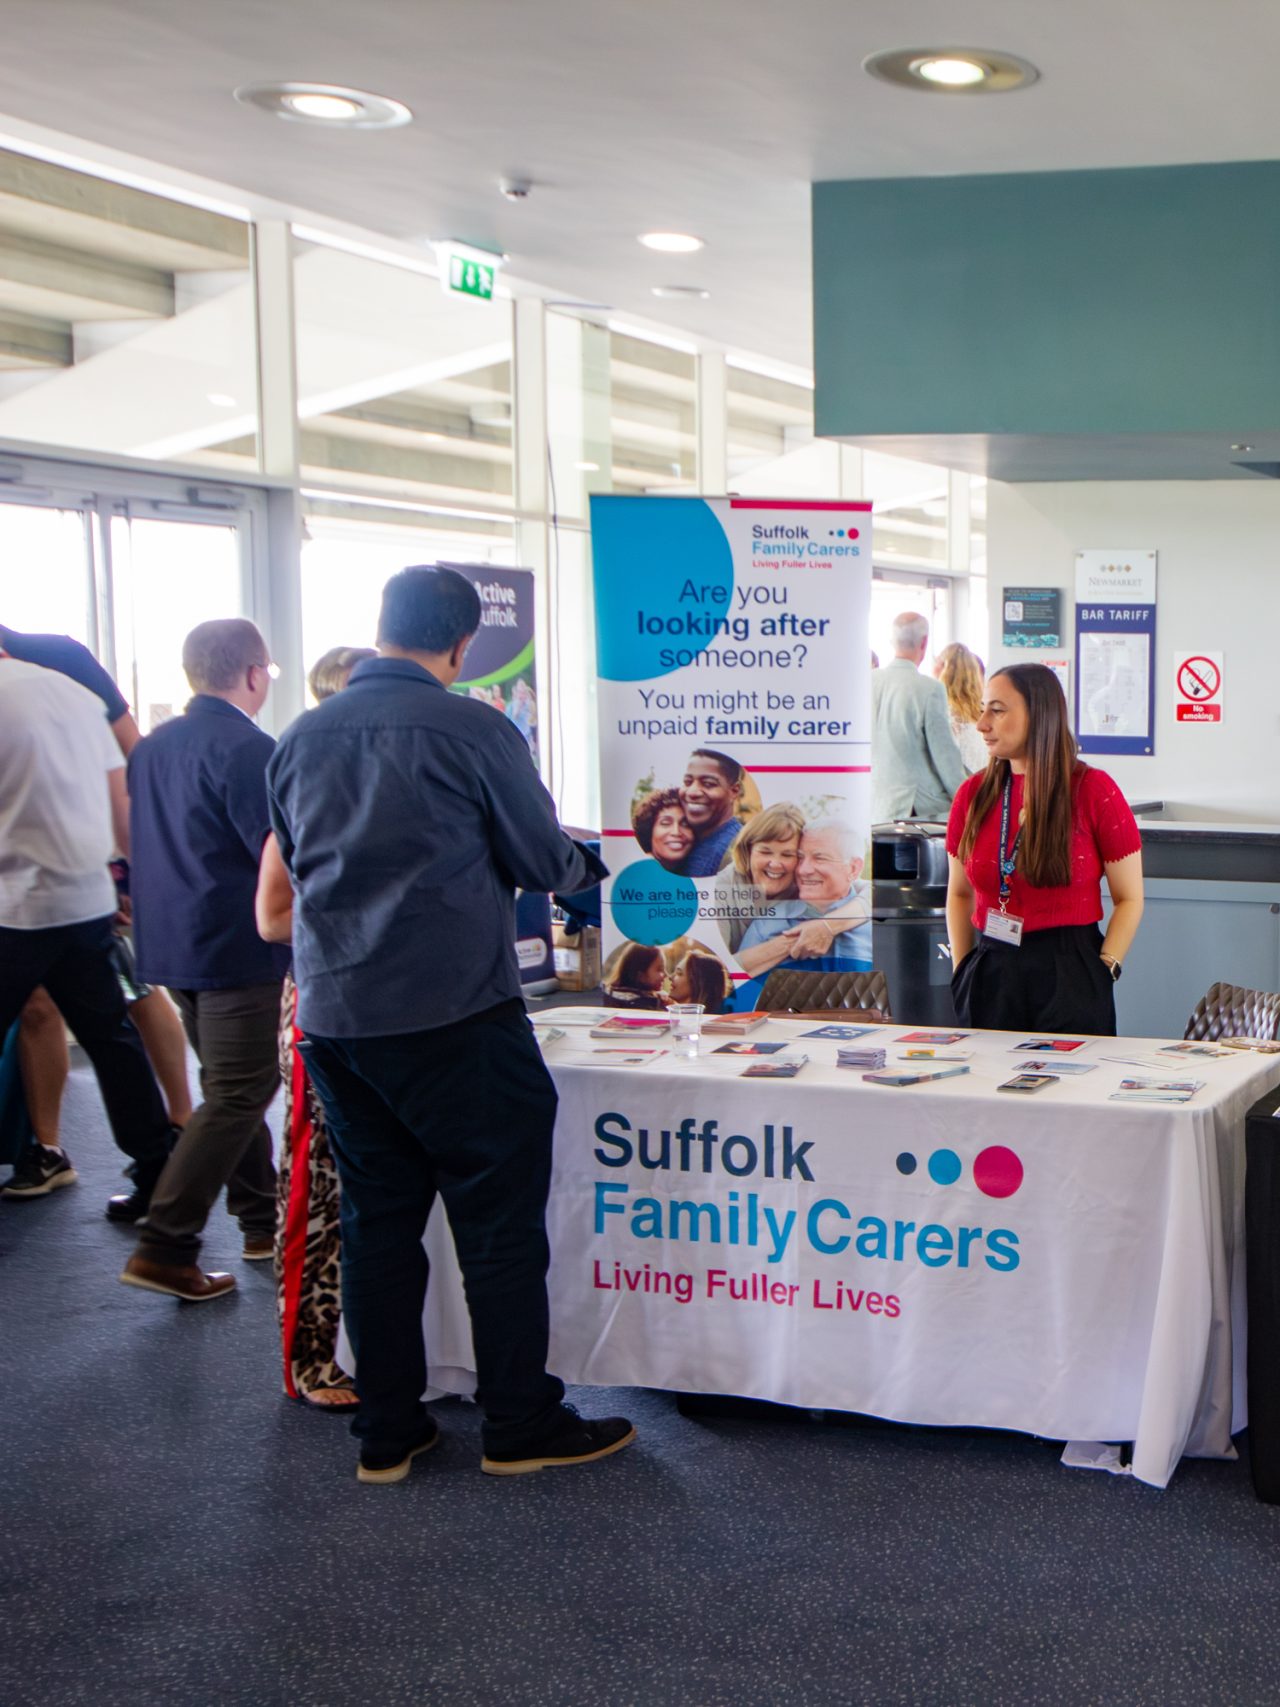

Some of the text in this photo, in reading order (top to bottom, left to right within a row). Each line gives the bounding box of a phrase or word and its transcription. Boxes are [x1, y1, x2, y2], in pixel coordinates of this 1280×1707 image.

[752, 524, 809, 540] Suffolk
[752, 560, 833, 570] Living Fuller Lives
[678, 579, 788, 609] Are you
[481, 605, 518, 628] uffolk
[637, 611, 830, 641] looking after
[1081, 609, 1149, 621] BAR TARIFF
[659, 644, 808, 668] someone?
[638, 689, 830, 714] You might be an
[618, 716, 851, 739] unpaid family carer
[1183, 711, 1214, 721] smoking
[620, 888, 761, 903] We are here to help
[648, 905, 776, 920] please contact us
[593, 1112, 815, 1182] Suffolk
[594, 1260, 901, 1319] Living Fuller Lives
